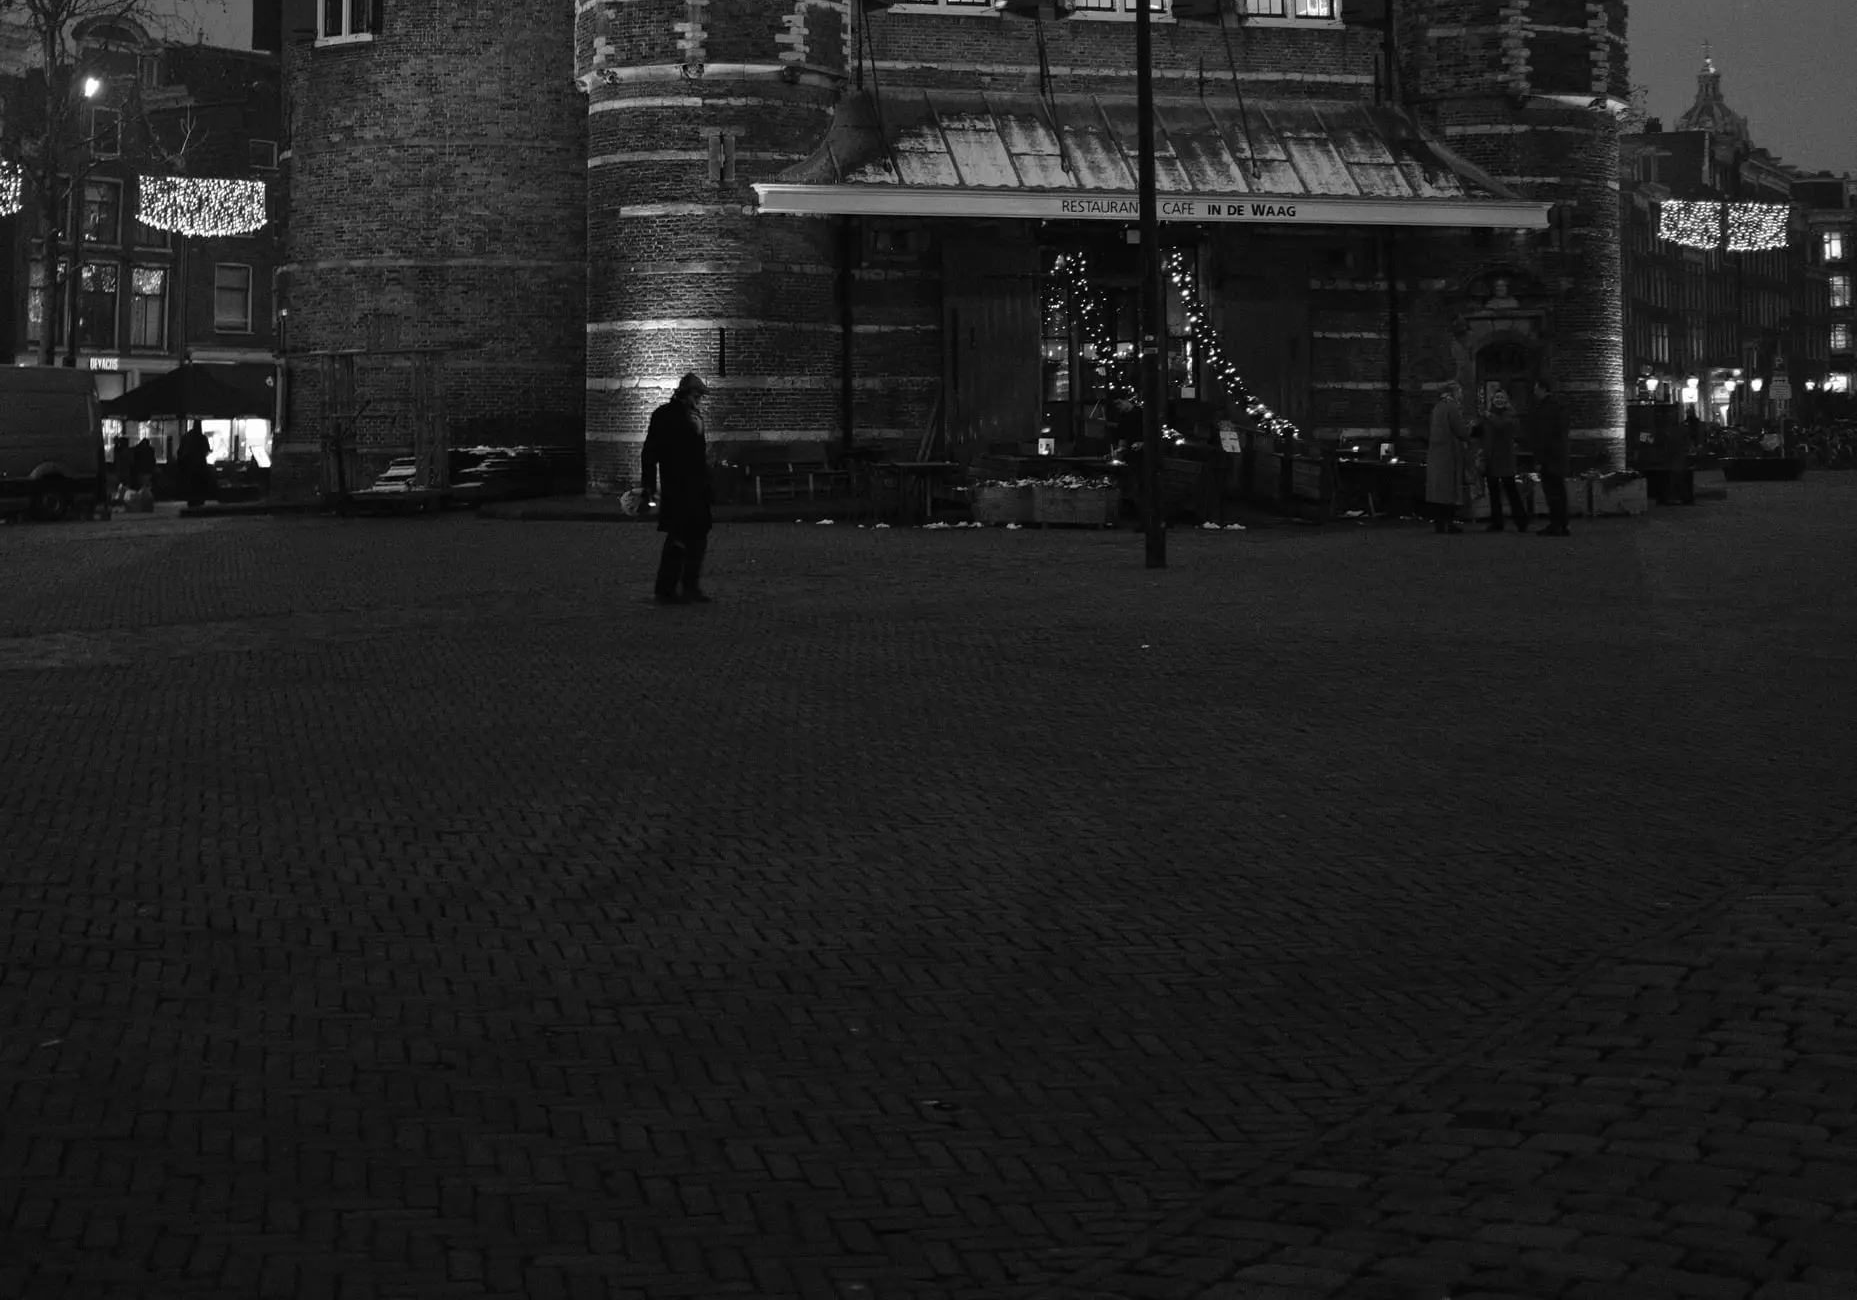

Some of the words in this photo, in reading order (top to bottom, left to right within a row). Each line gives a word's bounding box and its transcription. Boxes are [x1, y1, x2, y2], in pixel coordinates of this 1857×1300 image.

[1062, 200, 1139, 214] RESTAURAN
[1207, 204, 1221, 216] IN
[1227, 204, 1245, 216] DE
[1251, 203, 1297, 217] WAAG
